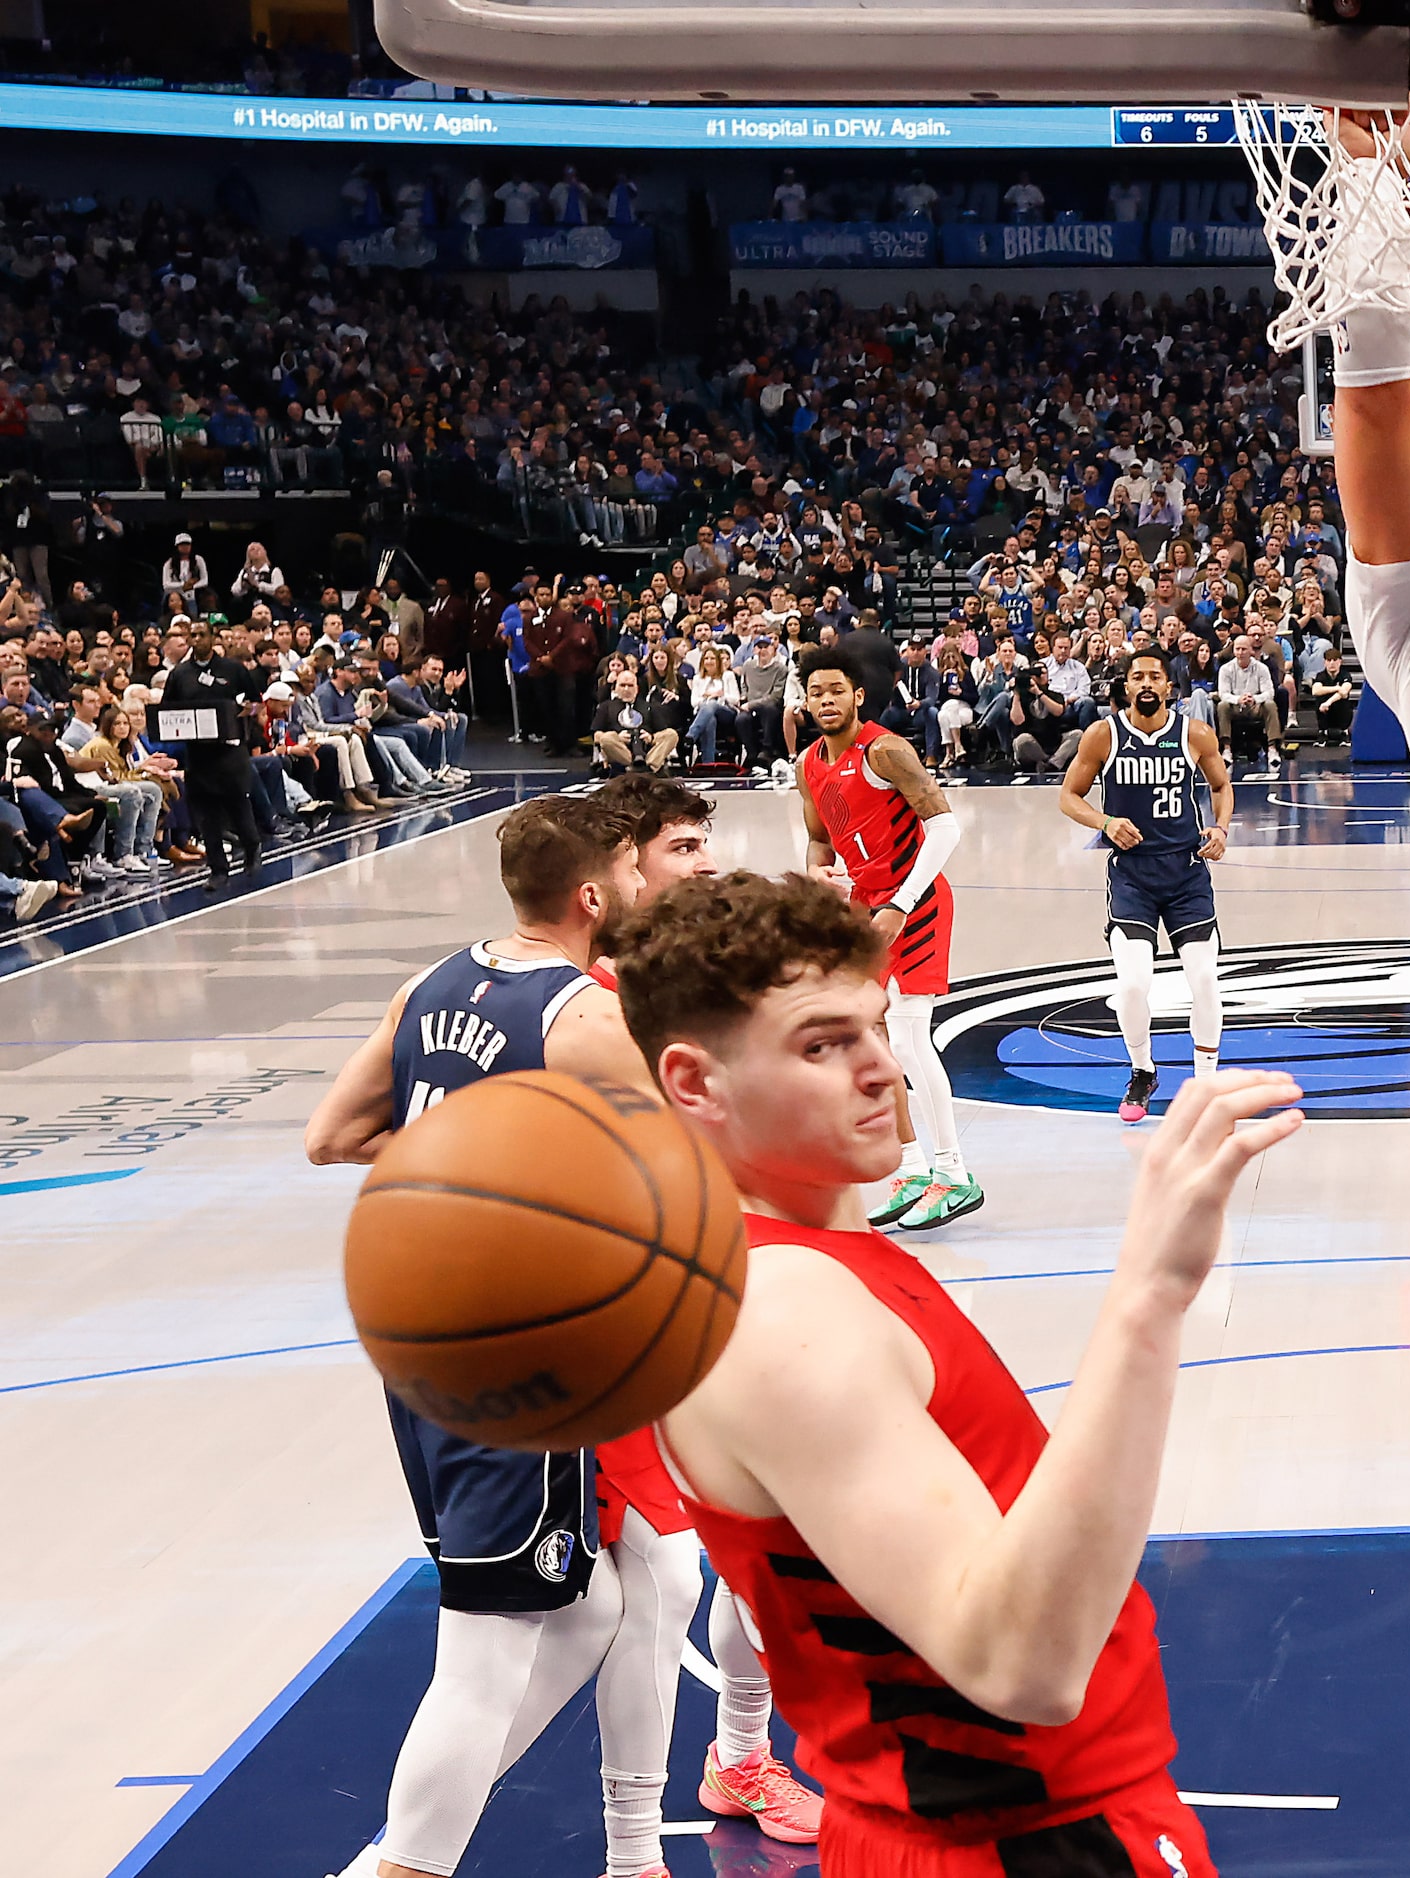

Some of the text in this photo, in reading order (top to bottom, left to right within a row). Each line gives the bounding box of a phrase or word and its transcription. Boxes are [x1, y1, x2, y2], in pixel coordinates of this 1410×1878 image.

[233, 108, 498, 135] #1 Hospital in DFW. Again.
[1121, 112, 1219, 122] TIMEOUTS FOULS
[706, 118, 951, 140] #1 Hospital in DFW. Again.
[1140, 126, 1208, 142] 6 5
[868, 231, 928, 244] SOUND
[1003, 224, 1113, 260] BREAKERS
[735, 245, 798, 260] ULTRA
[873, 244, 925, 257] STAGE
[1008, 609, 1023, 625] 41
[162, 717, 192, 726] ULTRA
[1115, 756, 1185, 785] MAVS
[1152, 786, 1182, 818] 26
[853, 832, 870, 861] 1
[420, 1009, 508, 1073] KLEBER
[83, 1067, 326, 1156] American
